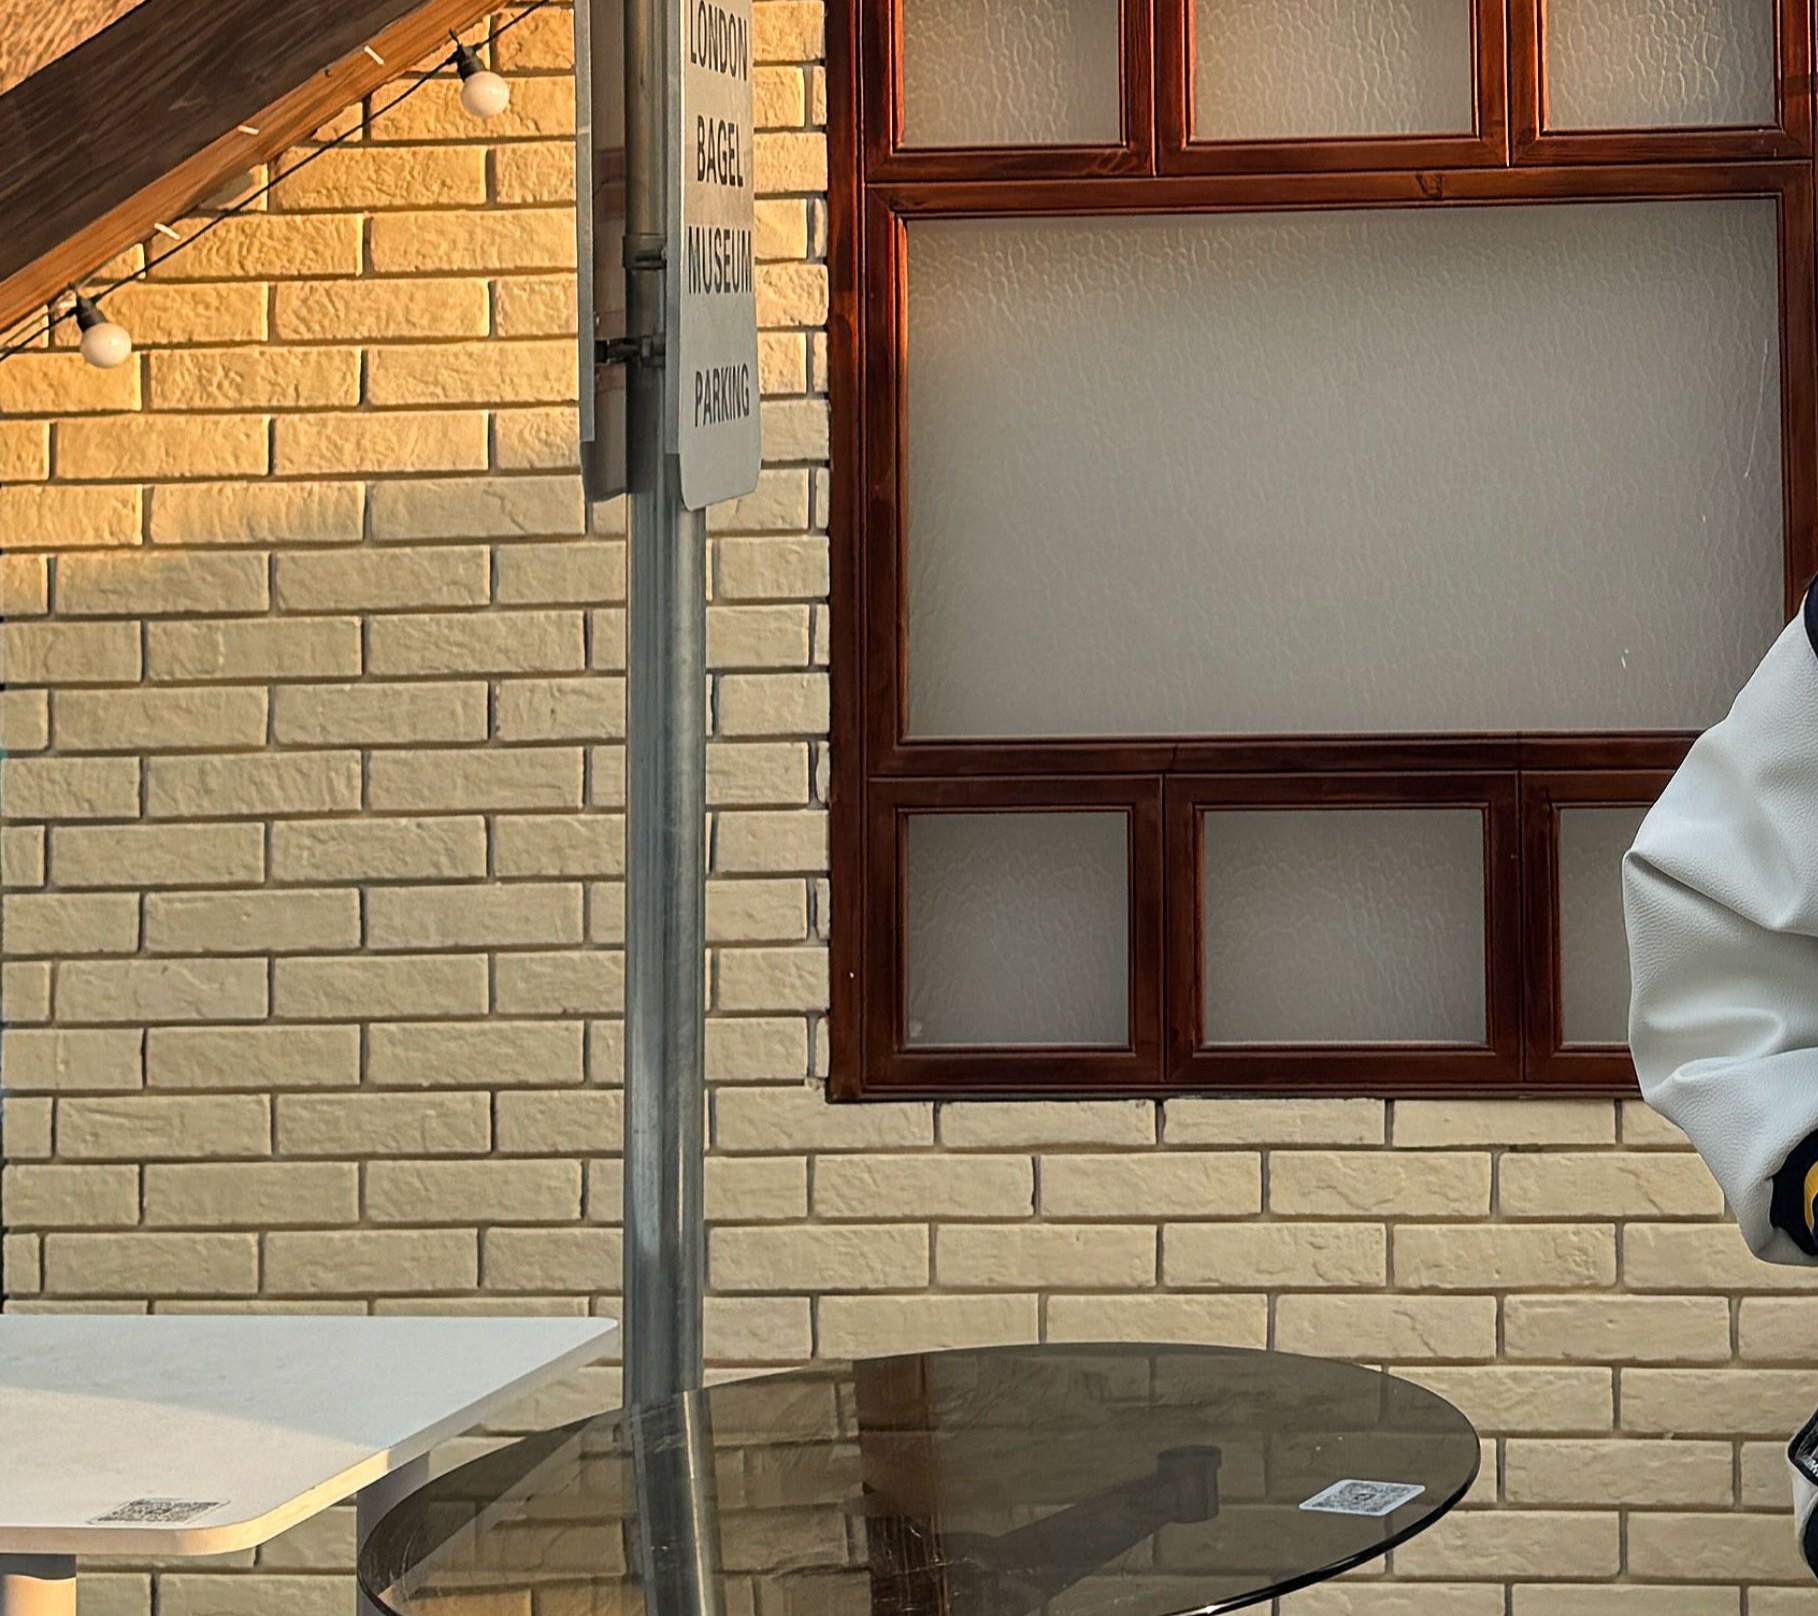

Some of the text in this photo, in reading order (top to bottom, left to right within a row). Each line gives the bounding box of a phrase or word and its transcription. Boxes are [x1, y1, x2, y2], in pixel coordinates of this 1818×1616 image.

[696, 114, 745, 188] BAGEL
[687, 225, 753, 295] MUSEUM
[694, 363, 750, 429] PARKING
